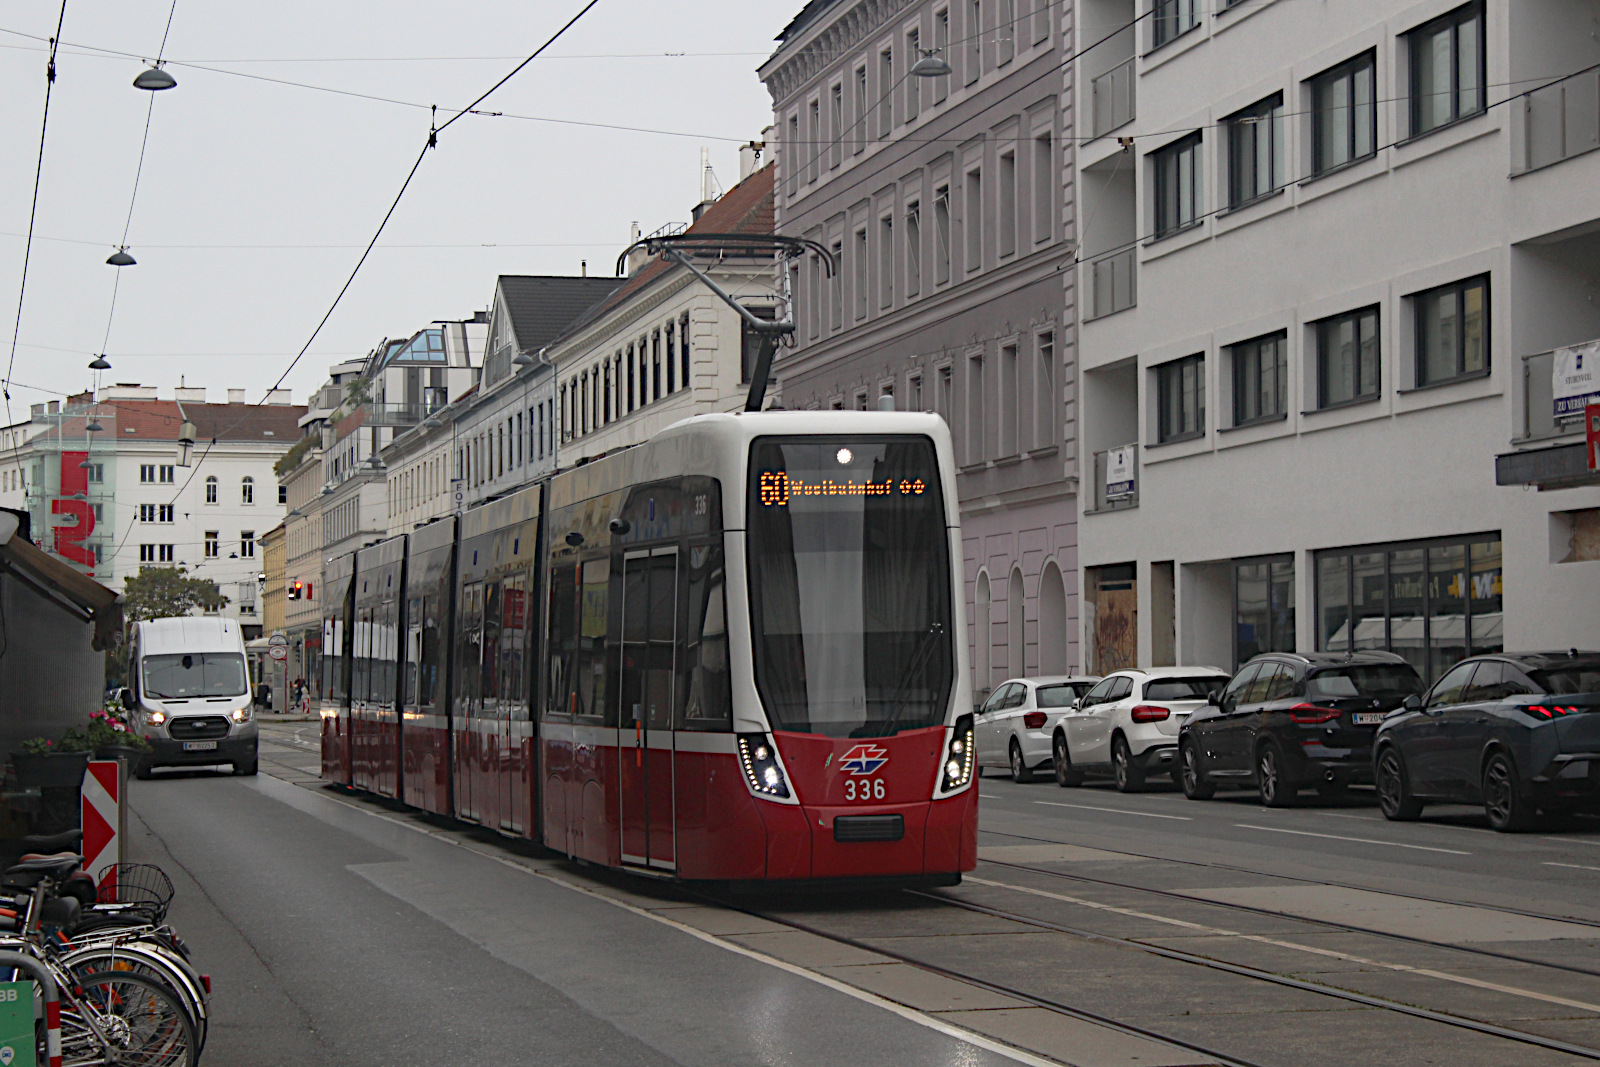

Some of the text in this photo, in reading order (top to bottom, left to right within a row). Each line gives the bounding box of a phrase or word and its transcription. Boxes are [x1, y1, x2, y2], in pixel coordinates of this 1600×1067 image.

[1558, 400, 1567, 411] ZU
[761, 471, 789, 506] 60
[694, 494, 707, 515] 336
[844, 778, 886, 801] 336
